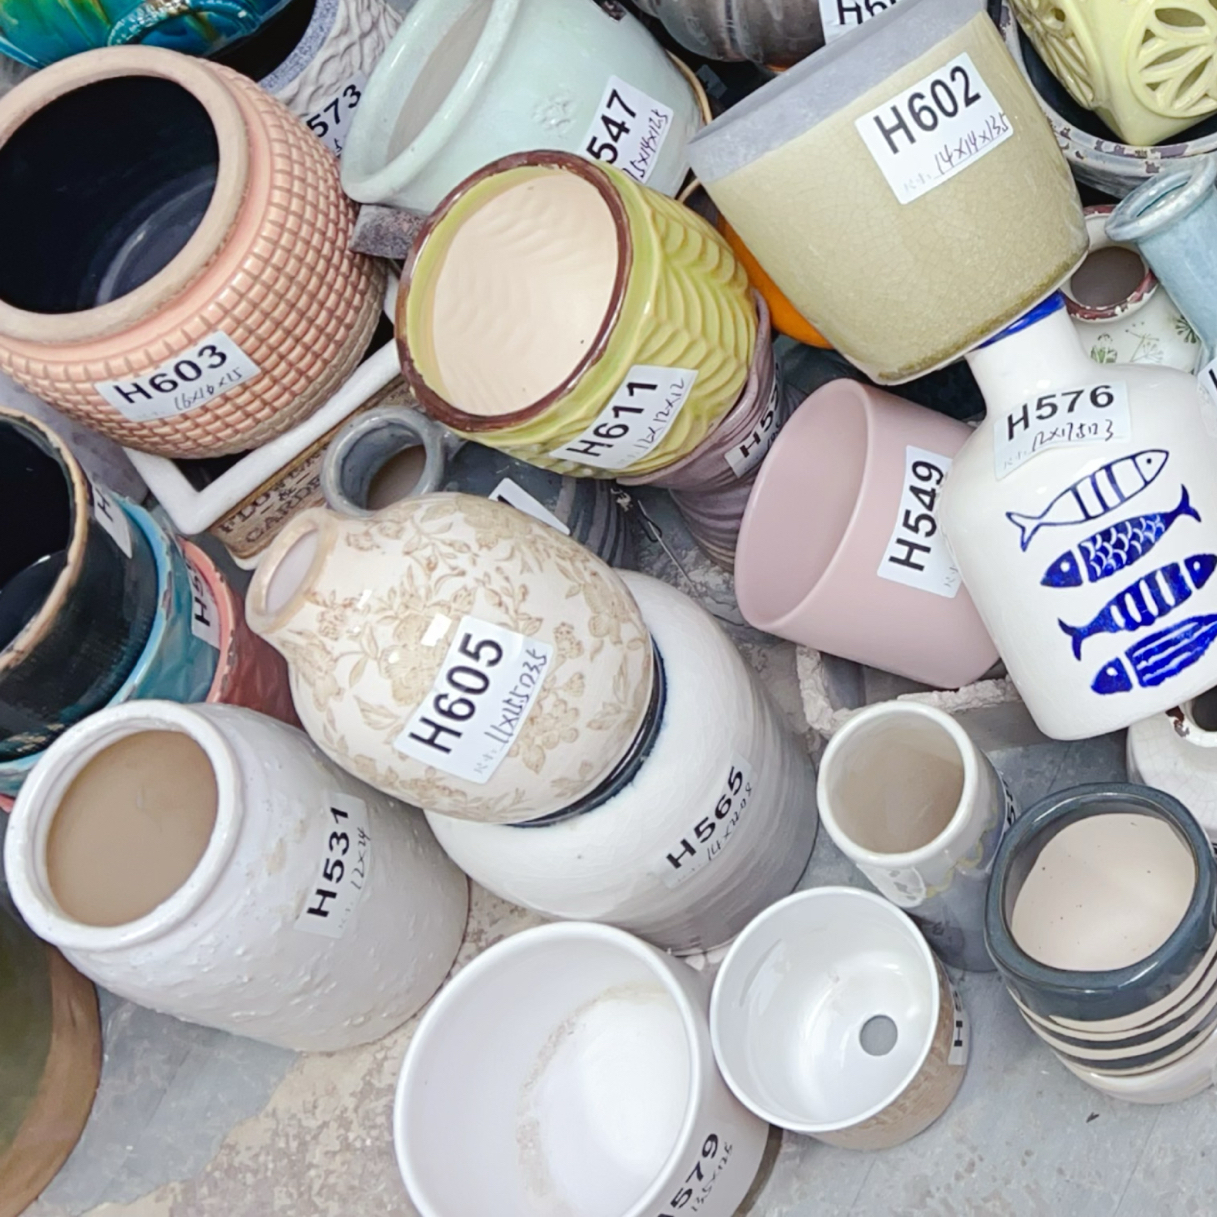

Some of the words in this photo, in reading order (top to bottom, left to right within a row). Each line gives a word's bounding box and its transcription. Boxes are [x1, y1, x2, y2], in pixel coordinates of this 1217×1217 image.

[875, 67, 980, 154] H602
[113, 344, 228, 406] H603
[567, 381, 658, 457] H611
[1007, 385, 1115, 440] H576
[889, 461, 944, 572] H549
[409, 633, 504, 754] H605
[307, 806, 350, 918] H531
[666, 765, 744, 870] H565
